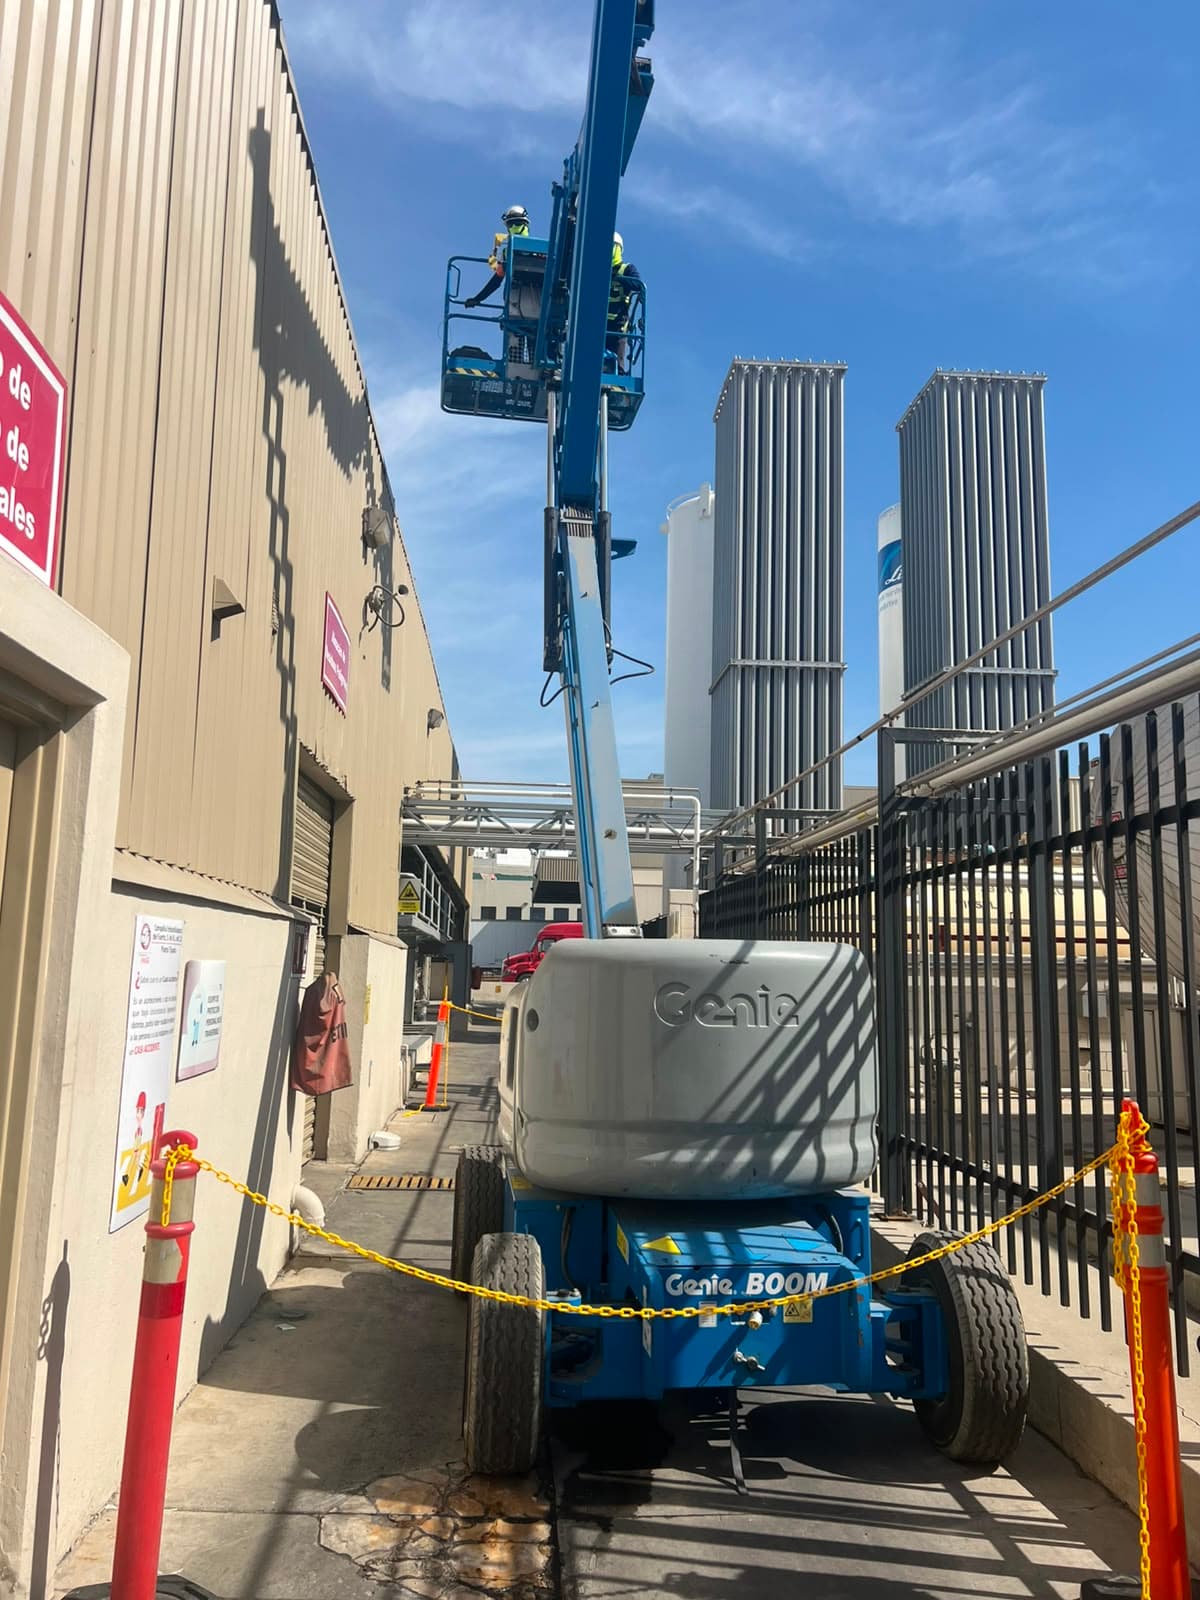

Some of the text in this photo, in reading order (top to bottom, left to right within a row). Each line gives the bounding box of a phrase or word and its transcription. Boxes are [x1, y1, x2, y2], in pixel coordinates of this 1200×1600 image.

[9, 364, 31, 411] de
[7, 426, 29, 472] de
[654, 981, 799, 1028] Genie
[665, 1272, 829, 1296] Genie BOOM
